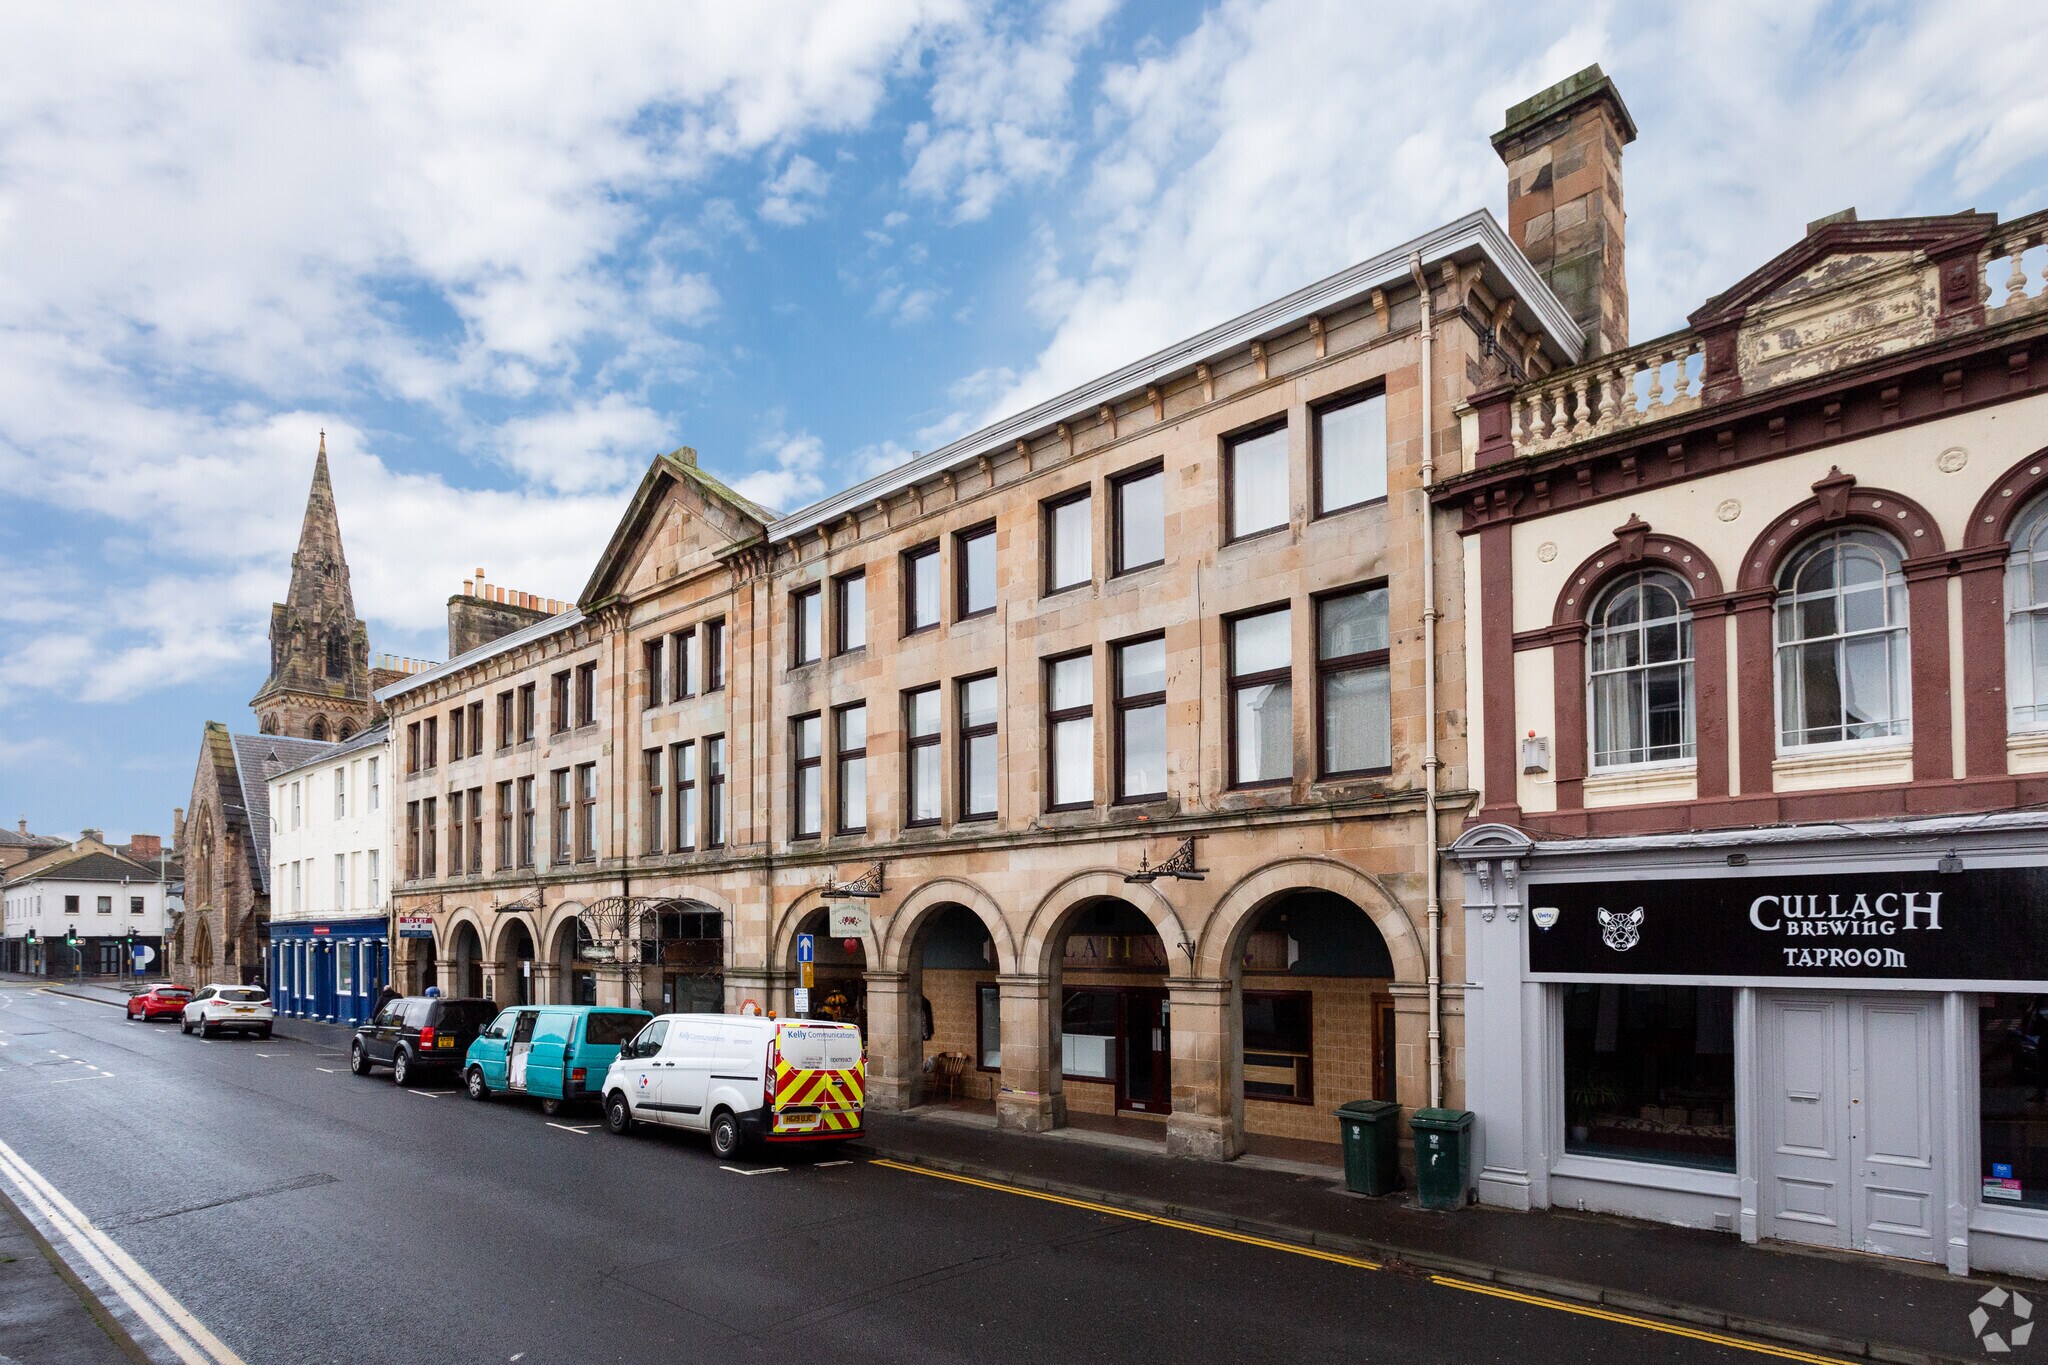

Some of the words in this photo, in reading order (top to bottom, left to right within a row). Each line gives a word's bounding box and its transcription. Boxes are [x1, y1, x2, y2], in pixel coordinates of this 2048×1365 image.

[1749, 891, 1943, 931] CULLACH
[1786, 920, 1897, 936] BREWING
[1783, 947, 1907, 968] TAPROOM
[787, 1031, 807, 1040] Kelly
[808, 1031, 855, 1039] Communications
